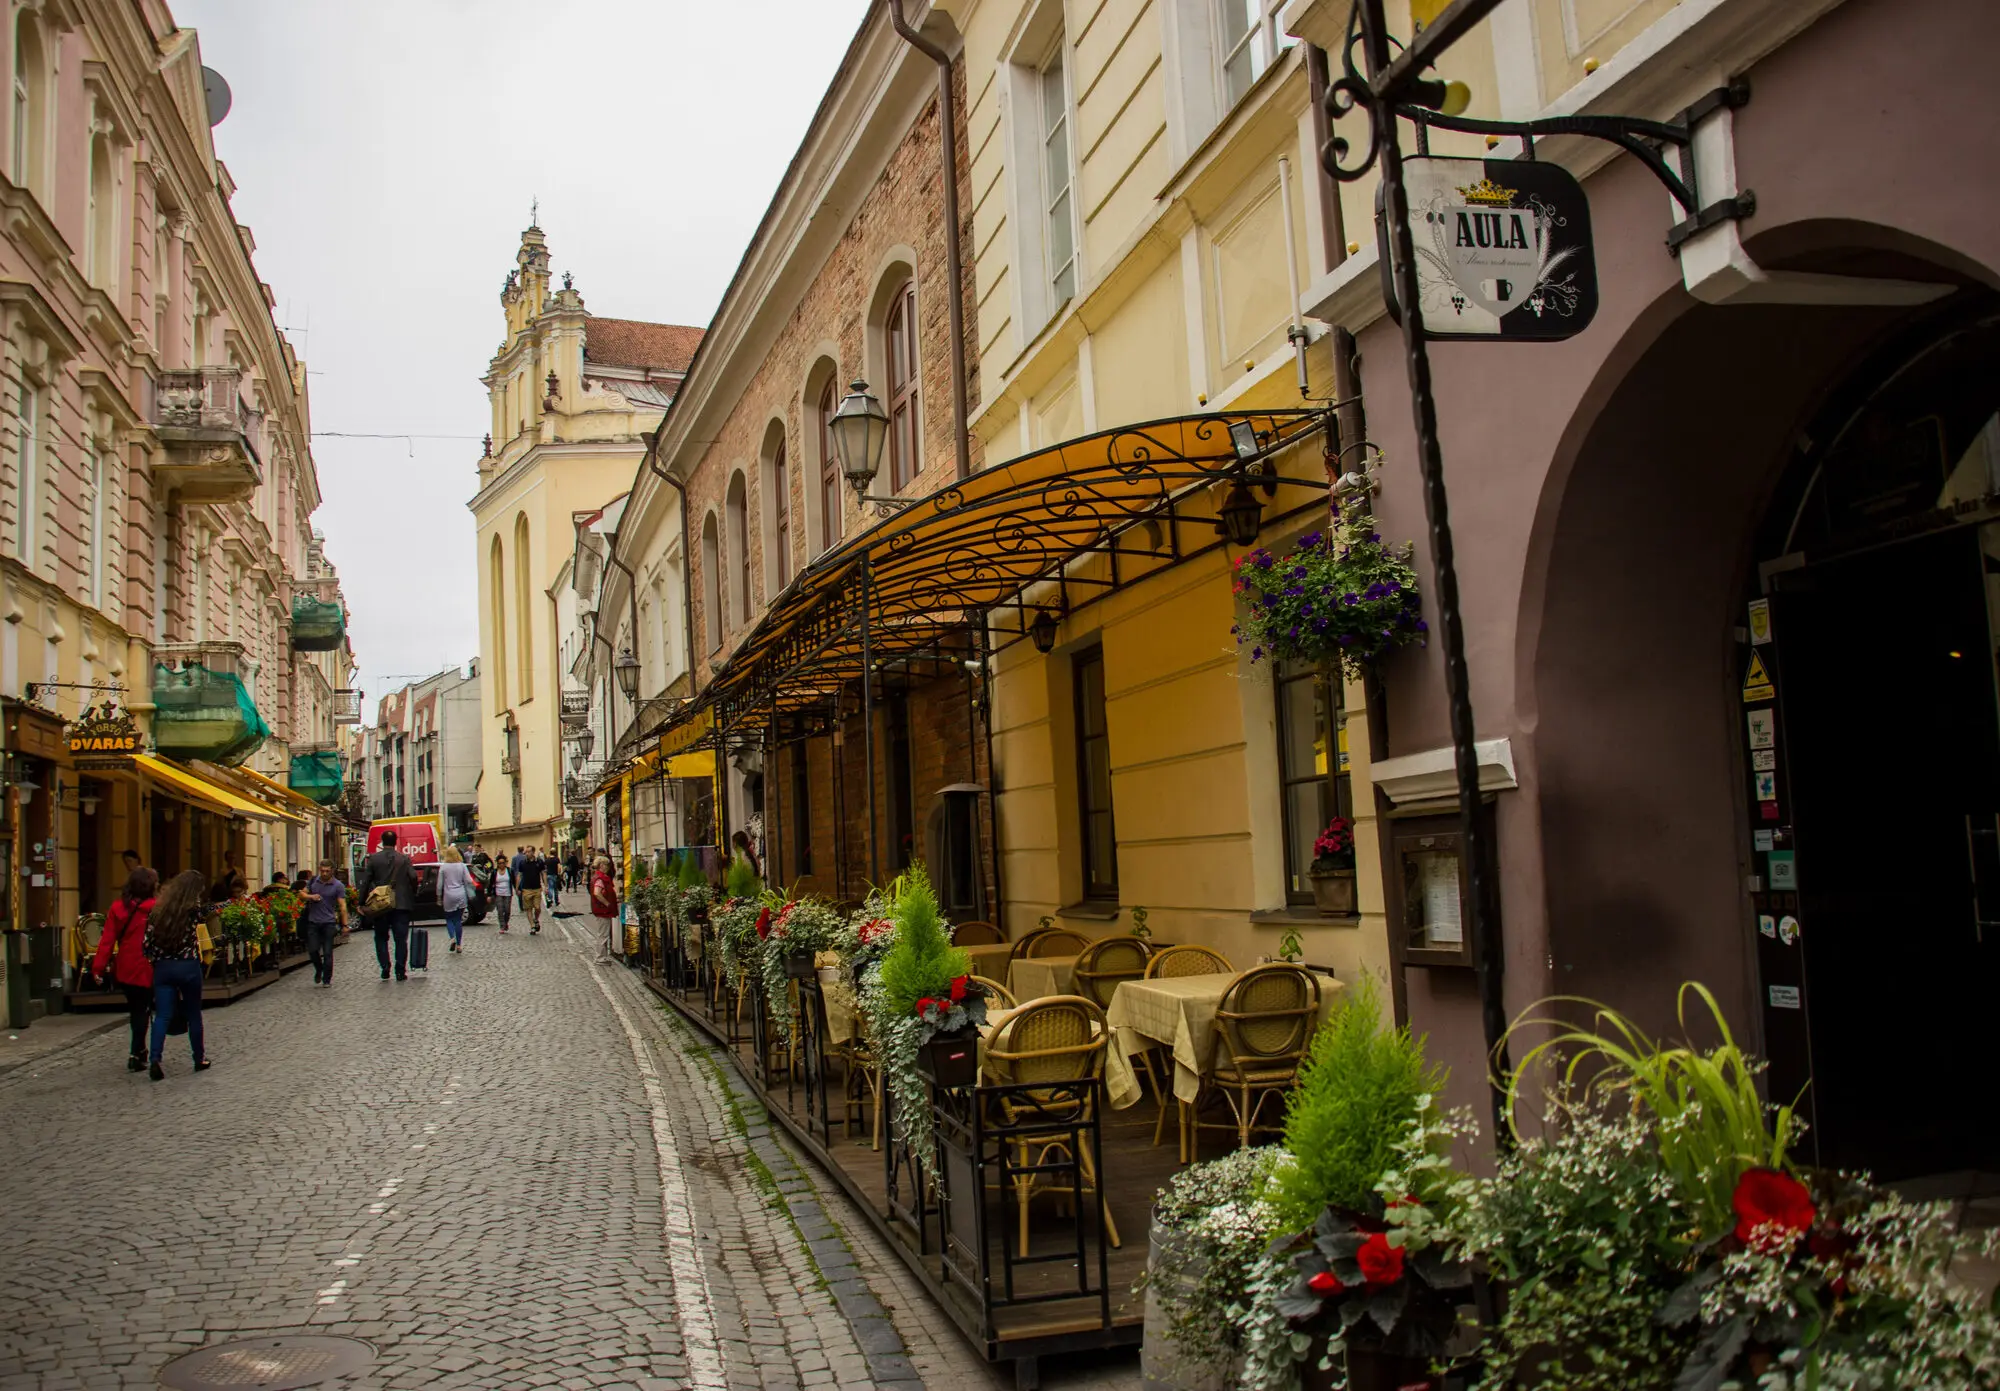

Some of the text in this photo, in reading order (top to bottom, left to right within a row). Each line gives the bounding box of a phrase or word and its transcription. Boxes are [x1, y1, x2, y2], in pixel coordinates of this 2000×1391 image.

[1455, 212, 1529, 250] AULA
[70, 737, 135, 751] DVARAS
[402, 841, 428, 857] dpd
